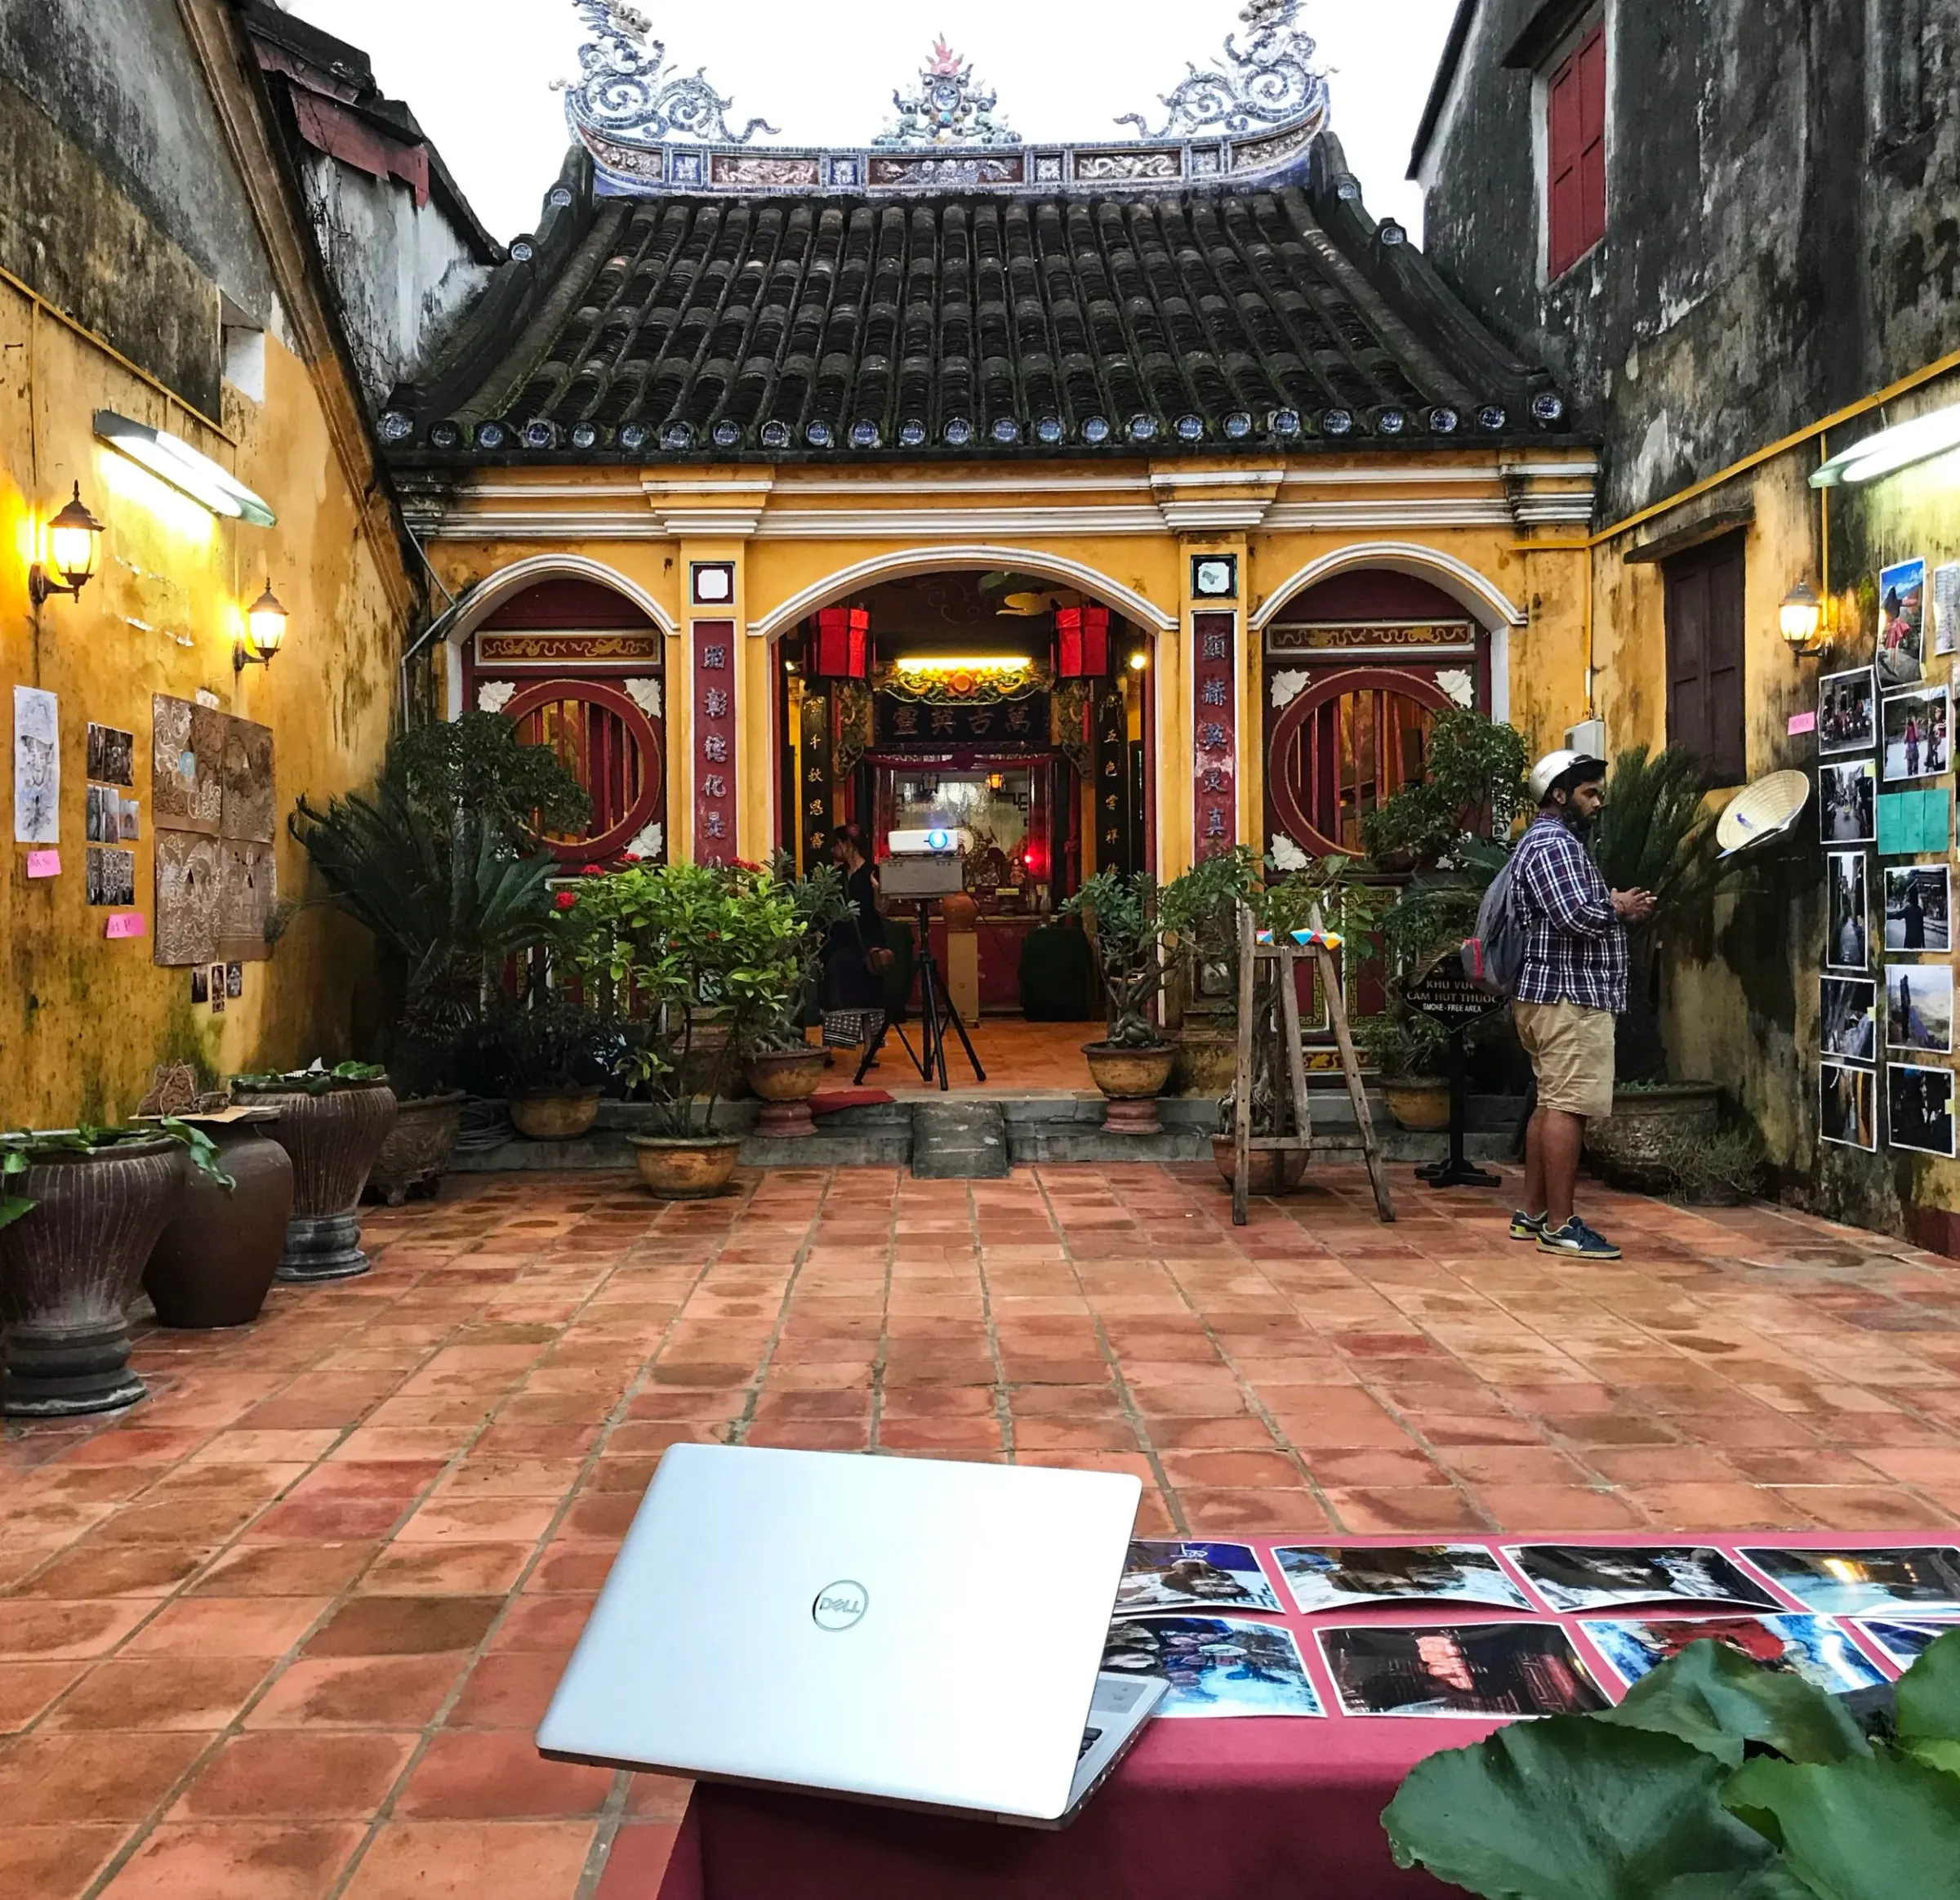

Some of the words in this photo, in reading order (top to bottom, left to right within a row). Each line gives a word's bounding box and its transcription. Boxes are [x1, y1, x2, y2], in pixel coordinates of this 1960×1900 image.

[1426, 979, 1450, 989] KHU
[1423, 1003, 1444, 1011] SMOKE
[1447, 1004, 1464, 1012] FREE
[1464, 1004, 1482, 1013] AREA
[819, 1597, 861, 1614] DELL
